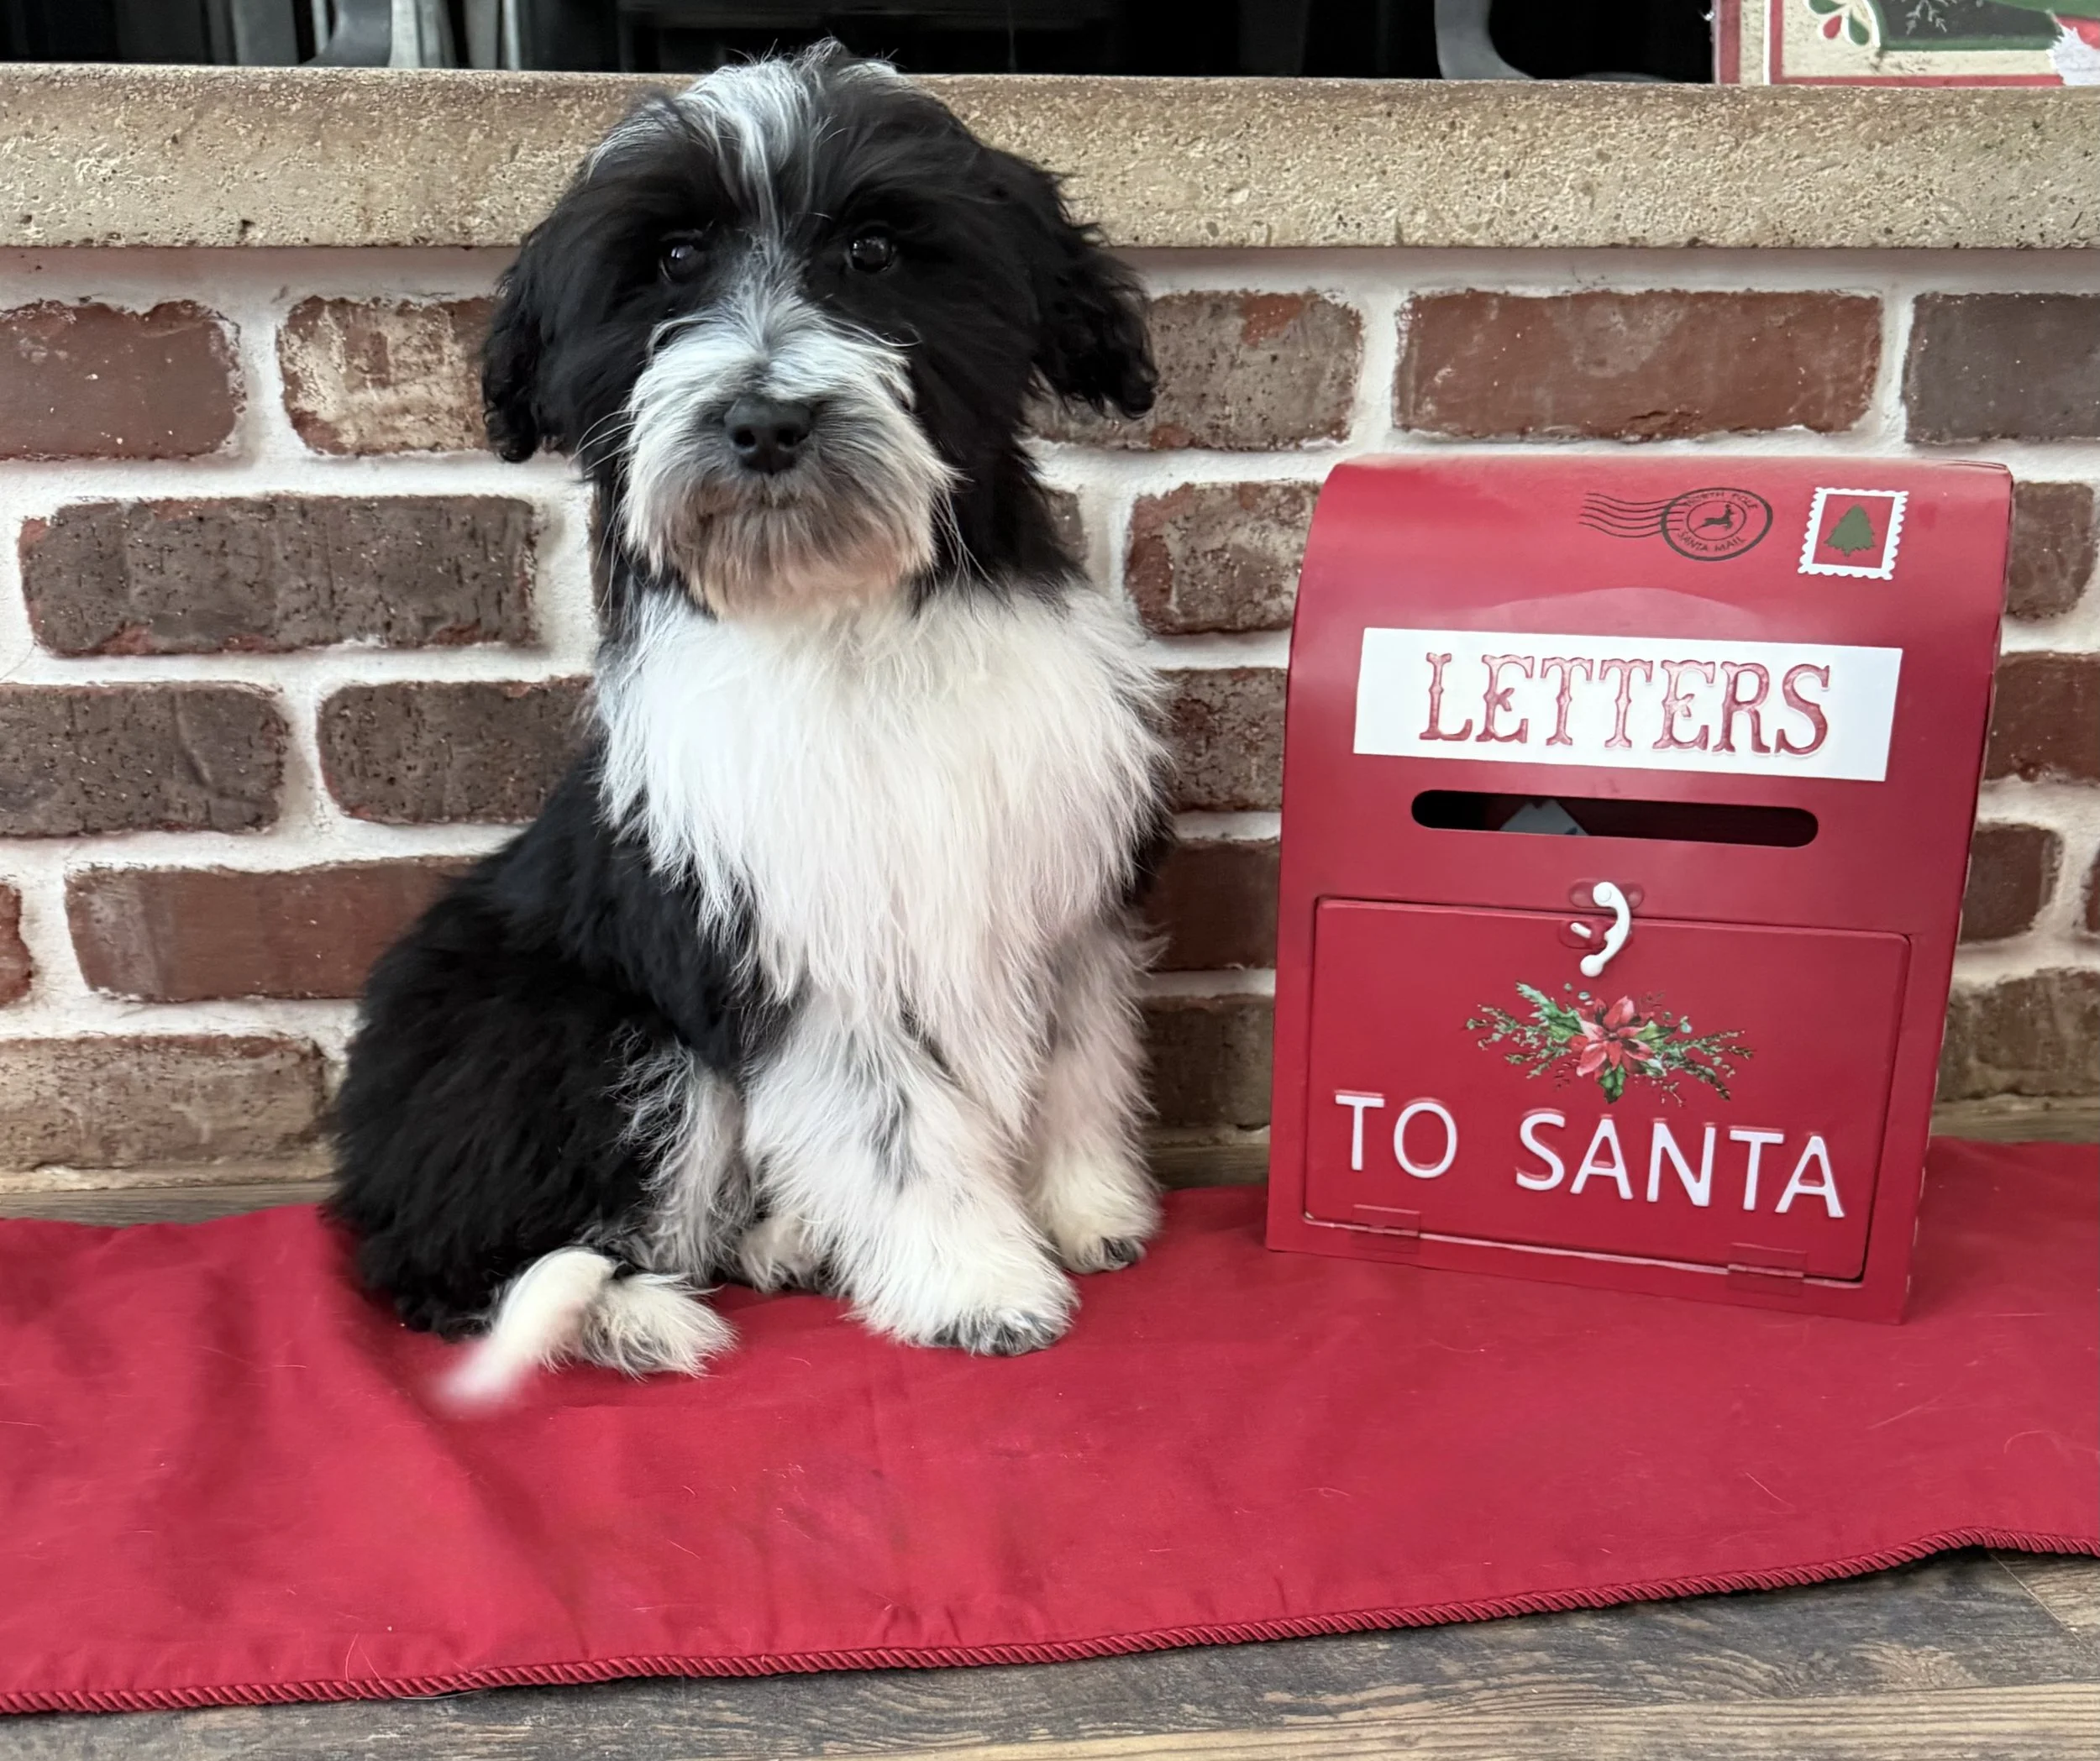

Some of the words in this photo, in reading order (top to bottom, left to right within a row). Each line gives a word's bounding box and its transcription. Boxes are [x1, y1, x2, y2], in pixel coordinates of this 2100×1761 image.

[1731, 493, 1758, 510] POLE
[1678, 531, 1709, 552] SANTA
[1714, 536, 1746, 552] MAIL
[1418, 652, 1831, 756] LETTERS
[1334, 1093, 1458, 1179] TO
[1515, 1111, 1845, 1219] SANTA
